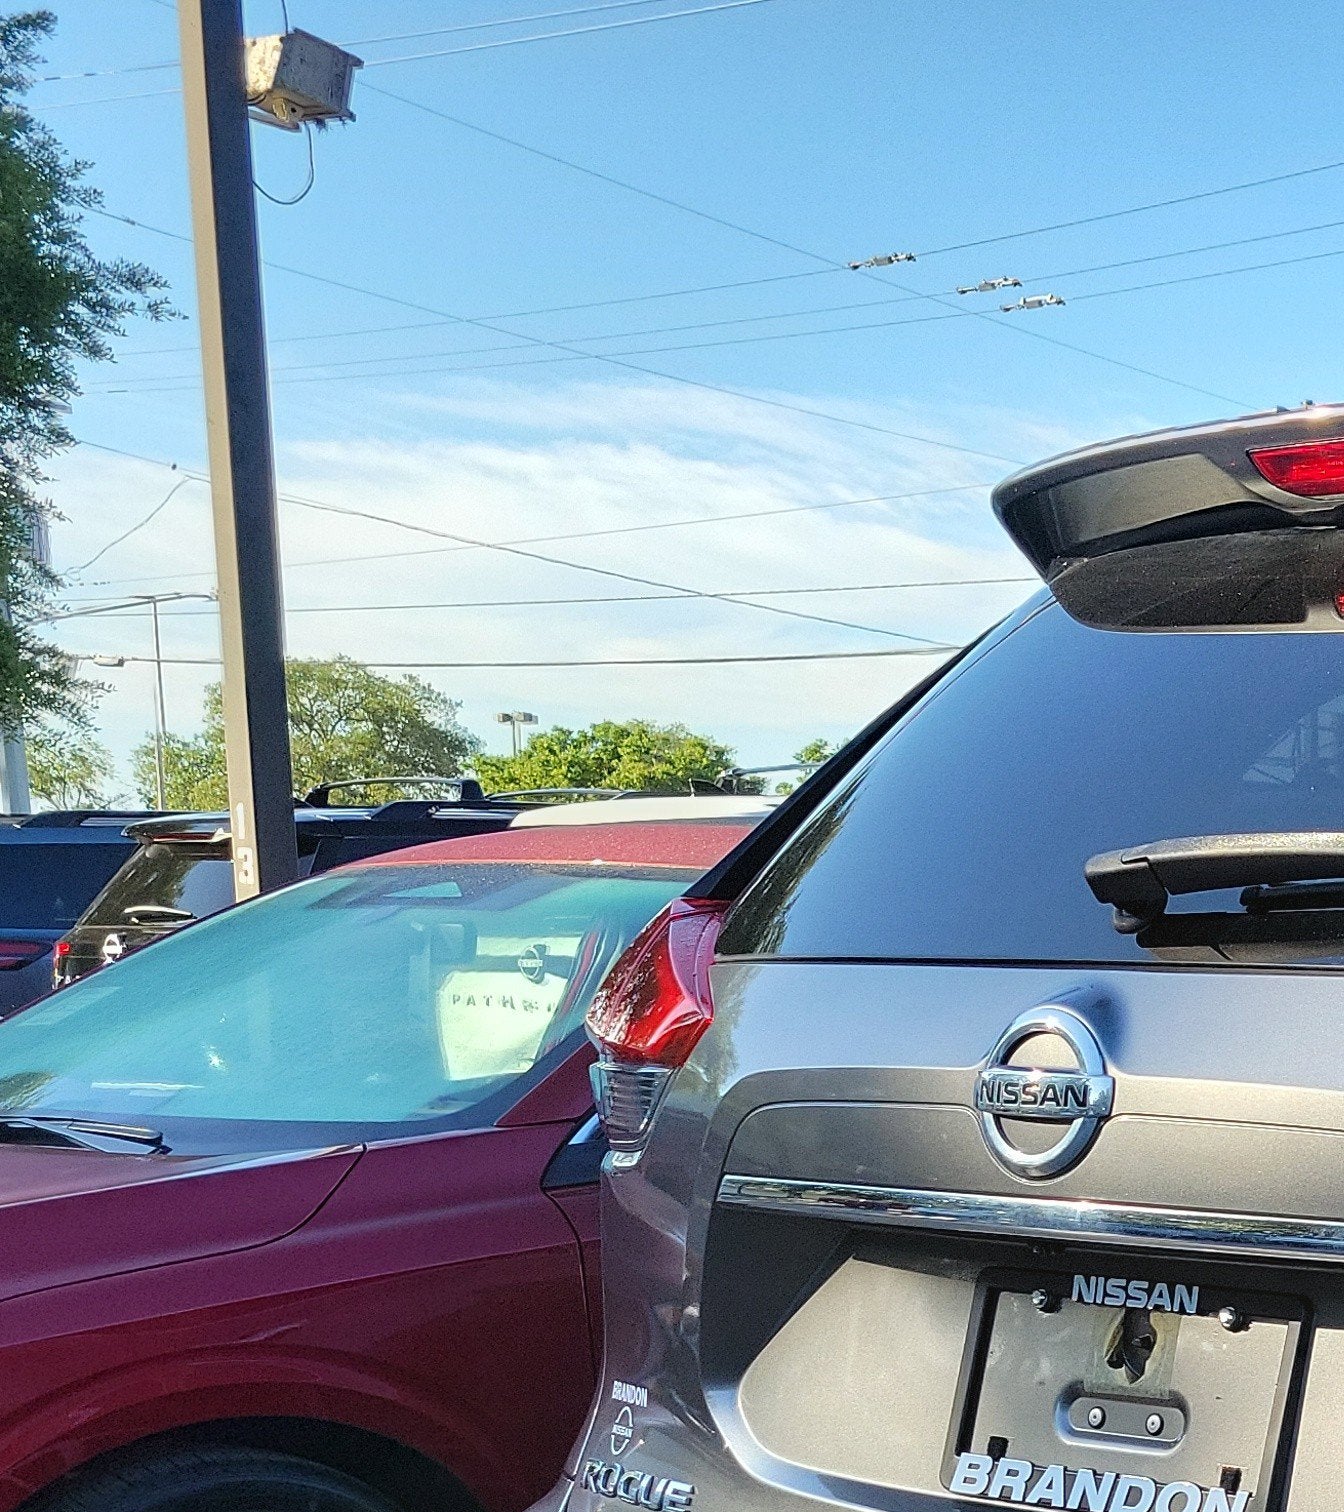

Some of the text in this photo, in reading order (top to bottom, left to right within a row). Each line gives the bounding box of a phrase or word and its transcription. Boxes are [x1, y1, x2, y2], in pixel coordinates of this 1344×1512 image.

[979, 1079, 1089, 1108] NISSAN
[1071, 1274, 1200, 1314] NISSAN
[612, 1380, 648, 1408] BRANDON
